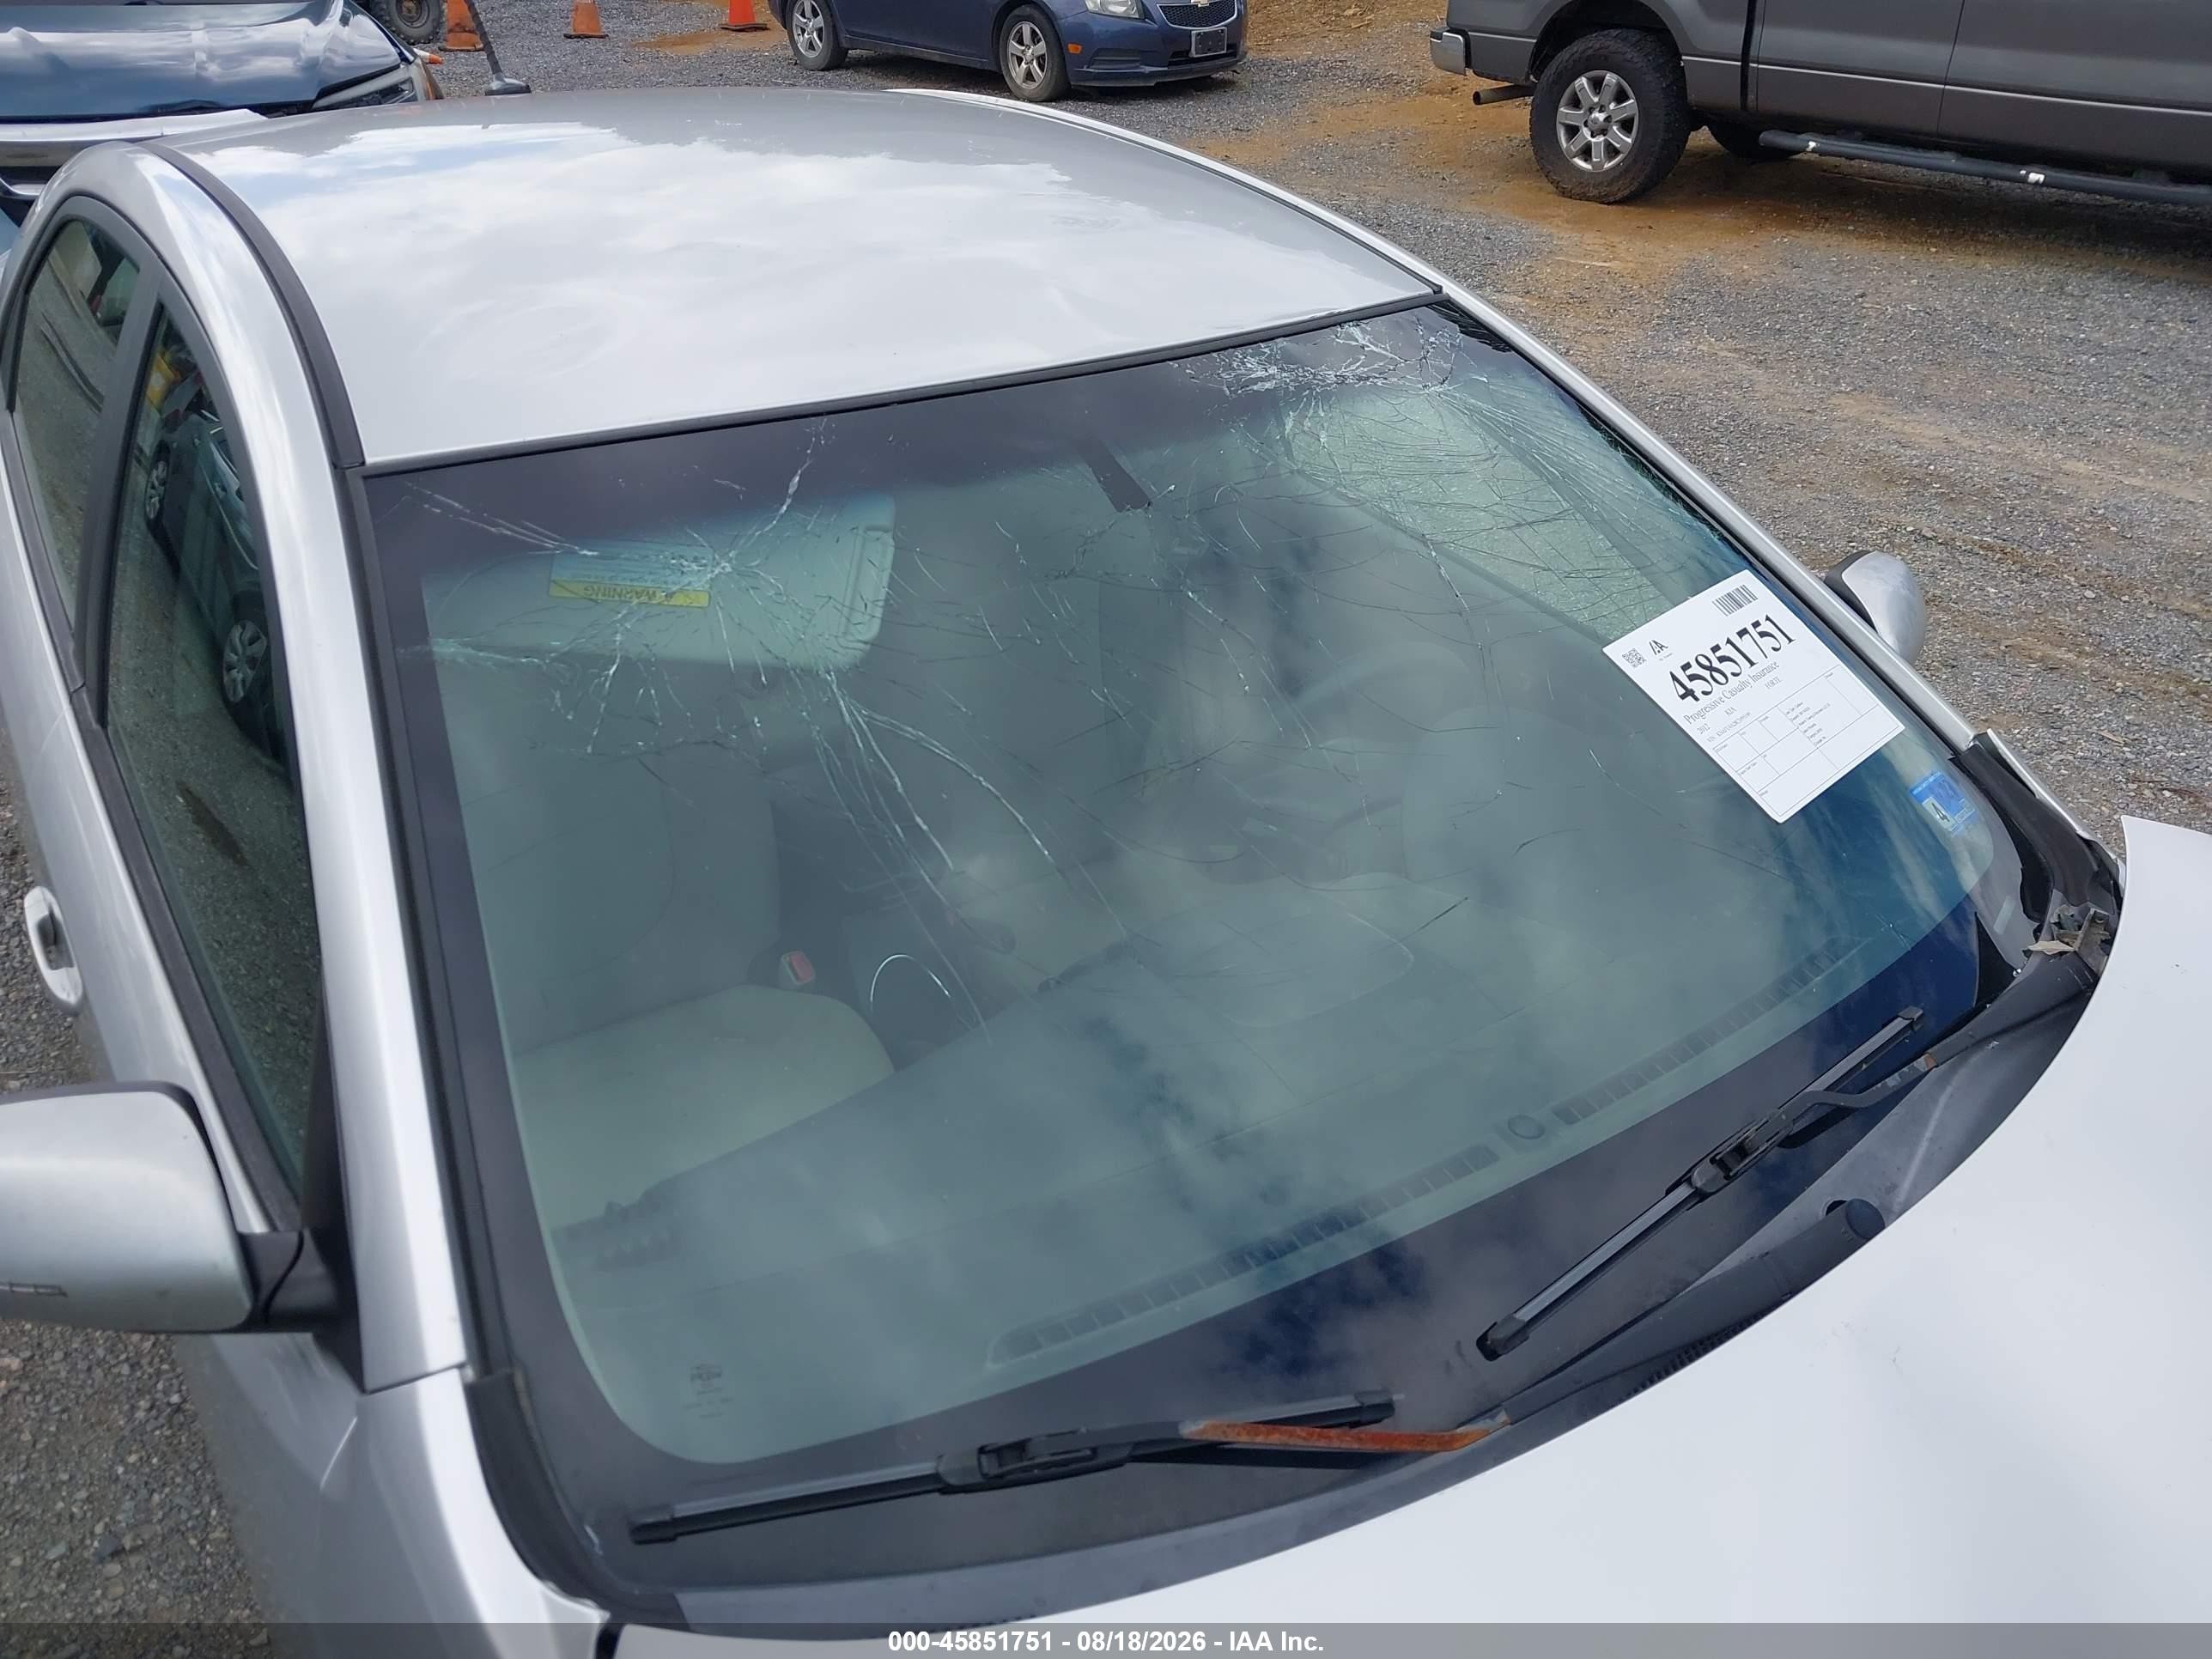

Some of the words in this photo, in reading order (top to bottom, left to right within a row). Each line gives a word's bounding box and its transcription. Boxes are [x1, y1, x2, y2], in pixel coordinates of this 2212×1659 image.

[583, 584, 658, 601] WARNING
[1669, 614, 1796, 702] 45851751
[1683, 695, 1726, 725] Progressive
[1722, 678, 1753, 701] Casualty
[1747, 660, 1780, 683] Insurance
[1931, 802, 1950, 823] 4
